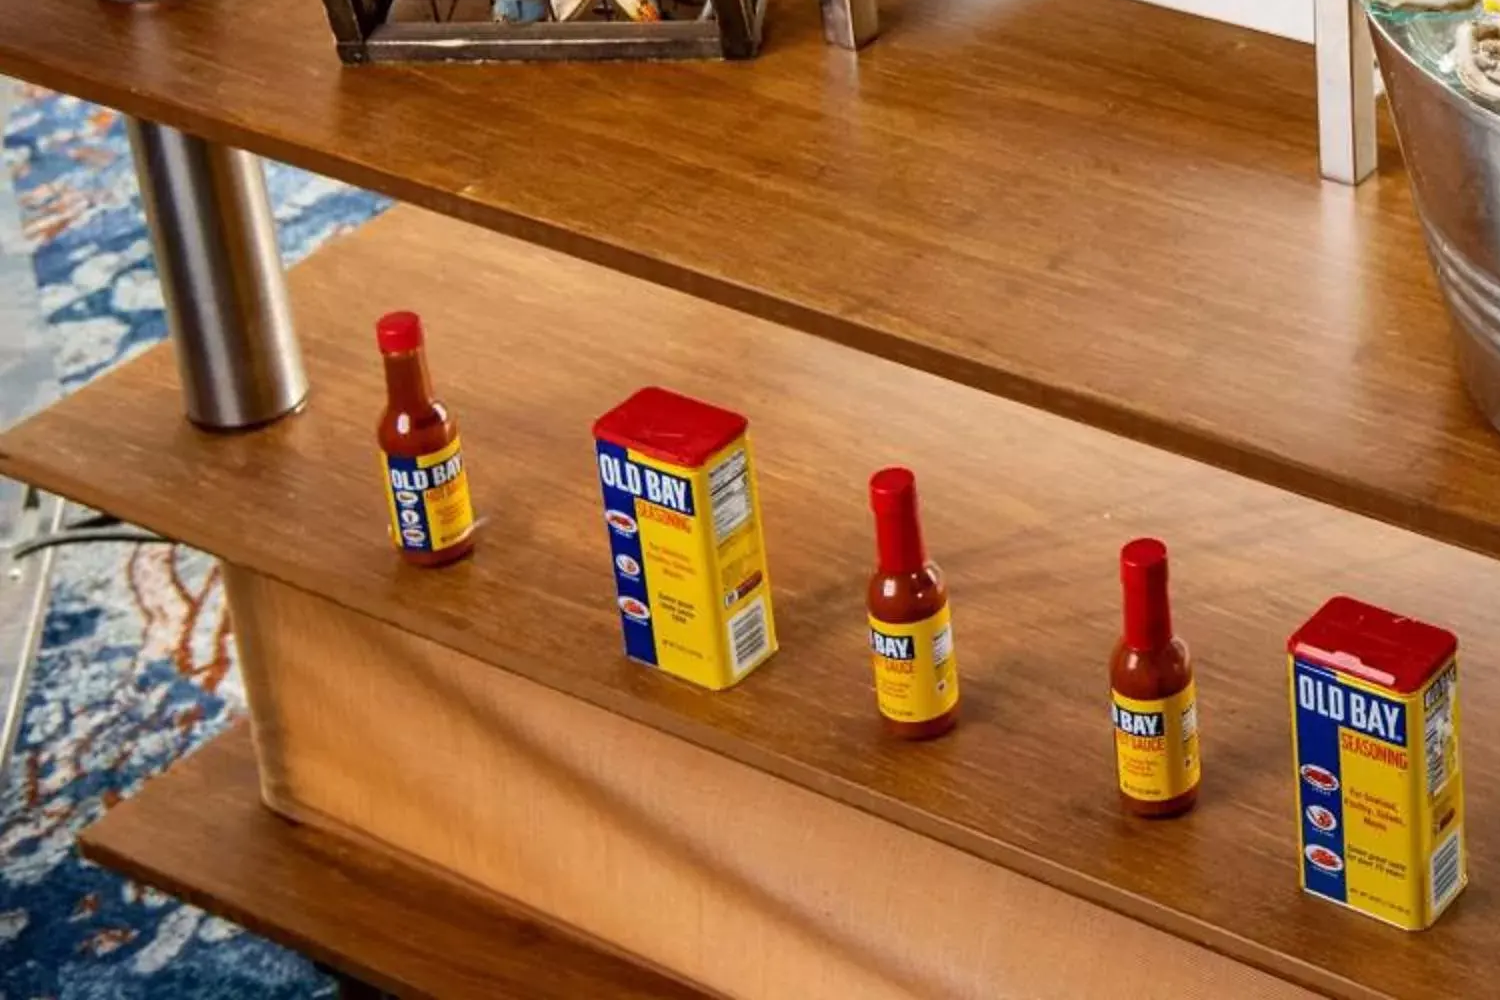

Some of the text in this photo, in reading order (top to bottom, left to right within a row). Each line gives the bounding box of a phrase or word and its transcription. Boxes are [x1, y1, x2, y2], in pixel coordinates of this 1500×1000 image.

[391, 468, 429, 491] OLD
[599, 453, 643, 496] OLD
[644, 469, 688, 513] BAY
[873, 630, 908, 659] BAY
[1119, 708, 1158, 735] BAY
[1299, 674, 1401, 741] OLD BAY
[1341, 733, 1409, 769] SEASONING
